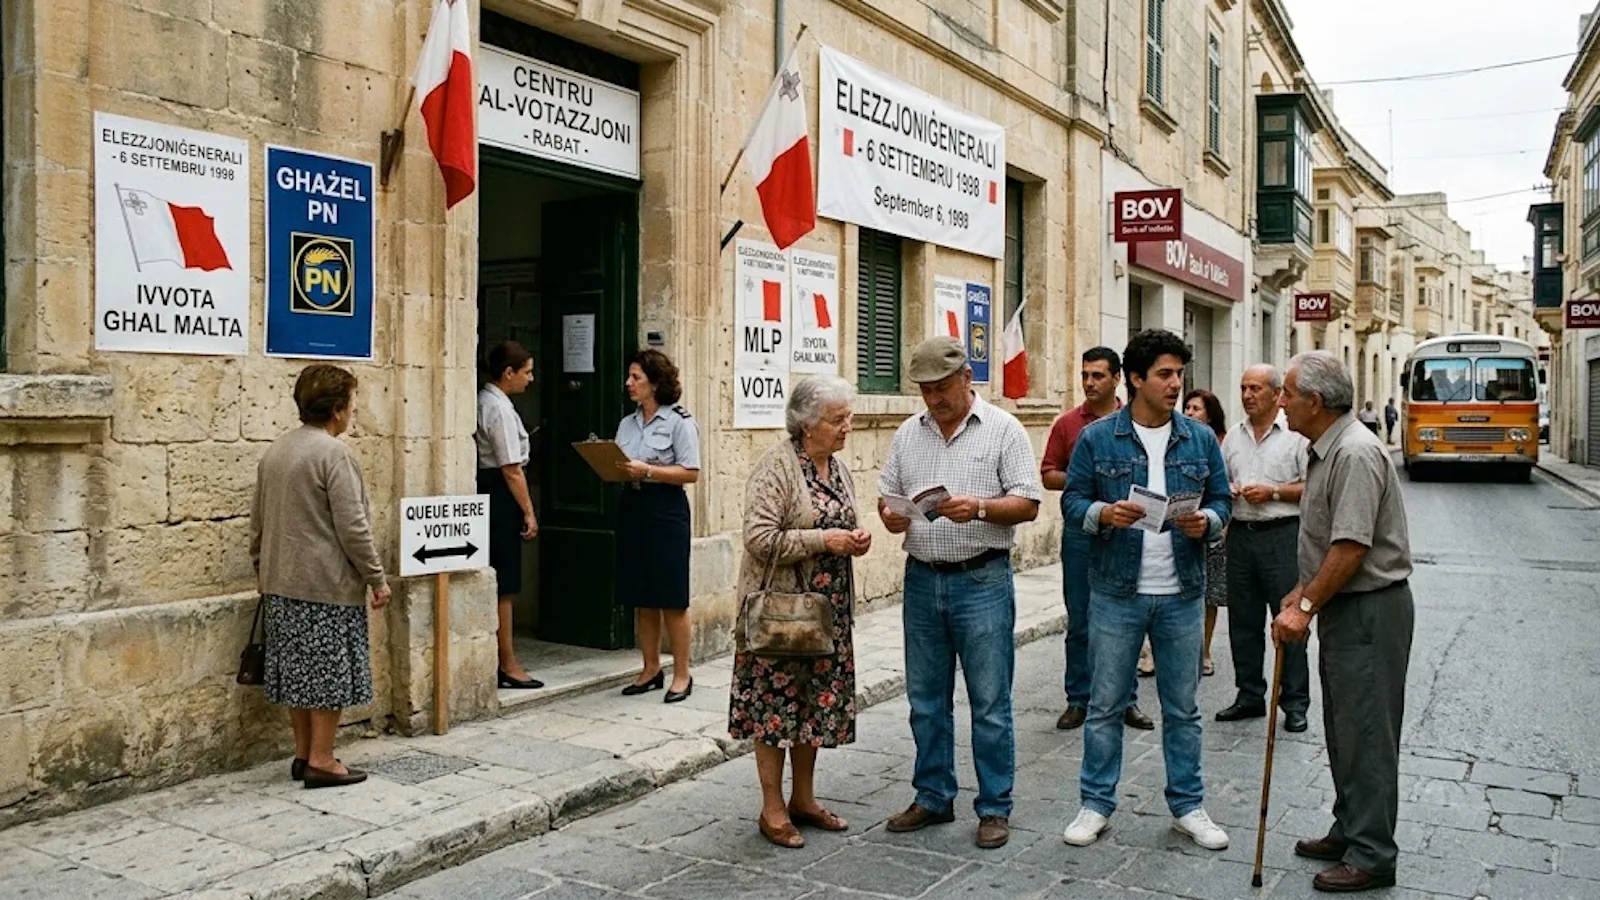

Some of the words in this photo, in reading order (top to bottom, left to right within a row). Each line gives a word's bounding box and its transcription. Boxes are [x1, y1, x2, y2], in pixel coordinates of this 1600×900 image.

[514, 66, 593, 107] CENTRU
[478, 84, 631, 144] AL-VOTAZZJONI
[837, 77, 996, 171] ELEZZJONIĠENERALI
[102, 128, 243, 165] ELEZZJONIĠENERALI
[533, 128, 581, 155] RABAT
[120, 151, 128, 163] 6
[131, 153, 206, 176] SETTEMBRU
[210, 166, 235, 181] 1998
[866, 139, 875, 163] 6
[878, 142, 953, 189] SETTEMBRU
[307, 200, 338, 225] PN
[873, 185, 934, 219] September
[1122, 197, 1174, 220] BOV
[1165, 239, 1188, 271] BOV
[305, 267, 341, 295] PN
[137, 284, 215, 309] IVVOTA
[1298, 297, 1327, 310] BOV
[103, 310, 167, 334] GHAL
[174, 314, 243, 338] MALTA
[744, 326, 782, 353] MLP
[740, 376, 784, 399] VOTA
[406, 504, 449, 521] QUEUE
[453, 502, 484, 517] HERE
[424, 522, 471, 538] VOTING
